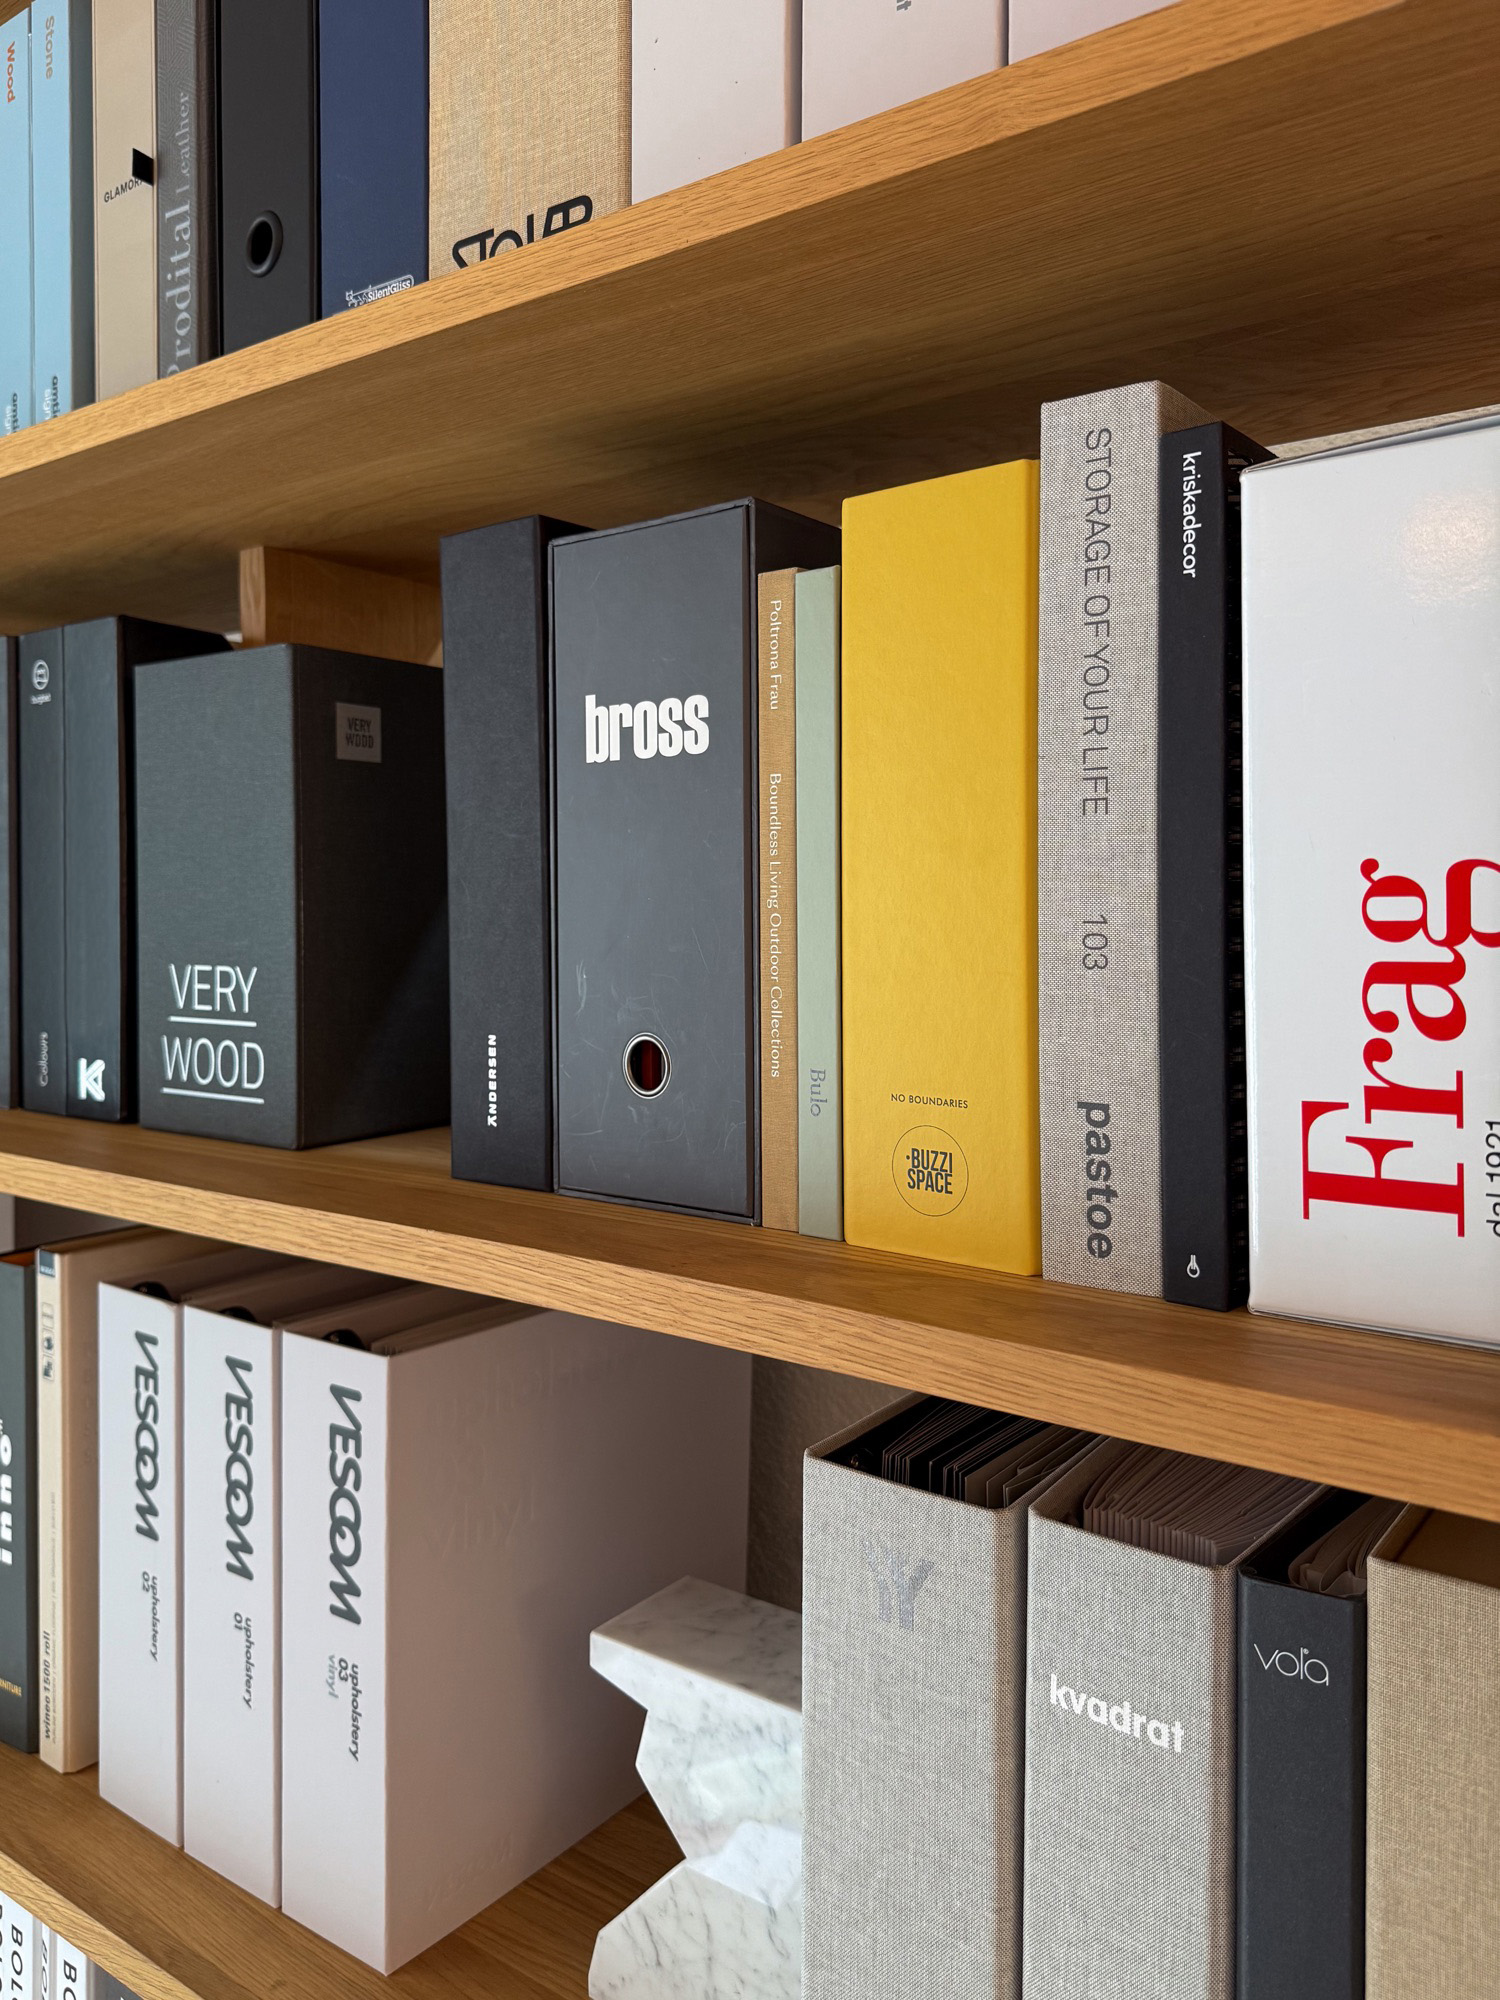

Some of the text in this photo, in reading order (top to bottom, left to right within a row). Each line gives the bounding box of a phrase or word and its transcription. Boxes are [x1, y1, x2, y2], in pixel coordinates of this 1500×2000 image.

[7, 41, 16, 104] Wood
[45, 15, 55, 80] Stone
[103, 177, 144, 202] GLAMOR
[1182, 451, 1202, 579] kriskadecor
[347, 716, 372, 733] VERY
[585, 694, 710, 764] bross
[1082, 427, 1112, 971] STORAGE OF YOUR LIFE 103
[767, 600, 784, 1078] Poltrona Frau Boundless Living Outdoor Collections
[169, 963, 258, 1013] VERY
[161, 1034, 265, 1089] WOOD
[1301, 858, 1500, 1238] Frag
[810, 1068, 828, 1118] Bulo
[891, 1093, 969, 1109] NO BOUNDARIES
[907, 1168, 953, 1195] SPACE
[1077, 1101, 1119, 1260] pastoe
[134, 1330, 160, 1542] VESCOM
[225, 1355, 254, 1581] VESCOM
[329, 1383, 363, 1625] VESCOM
[142, 1571, 151, 1593] 02
[150, 1576, 160, 1662] upholstery
[234, 1612, 243, 1632] 01
[43, 1660, 51, 1693] 1500
[243, 1617, 255, 1710] upholstery
[326, 1654, 339, 1700] vinyl
[338, 1657, 349, 1682] 03
[349, 1663, 363, 1762] upholstery
[1050, 1673, 1185, 1753] kvadrat
[11, 1923, 23, 2000] BOL
